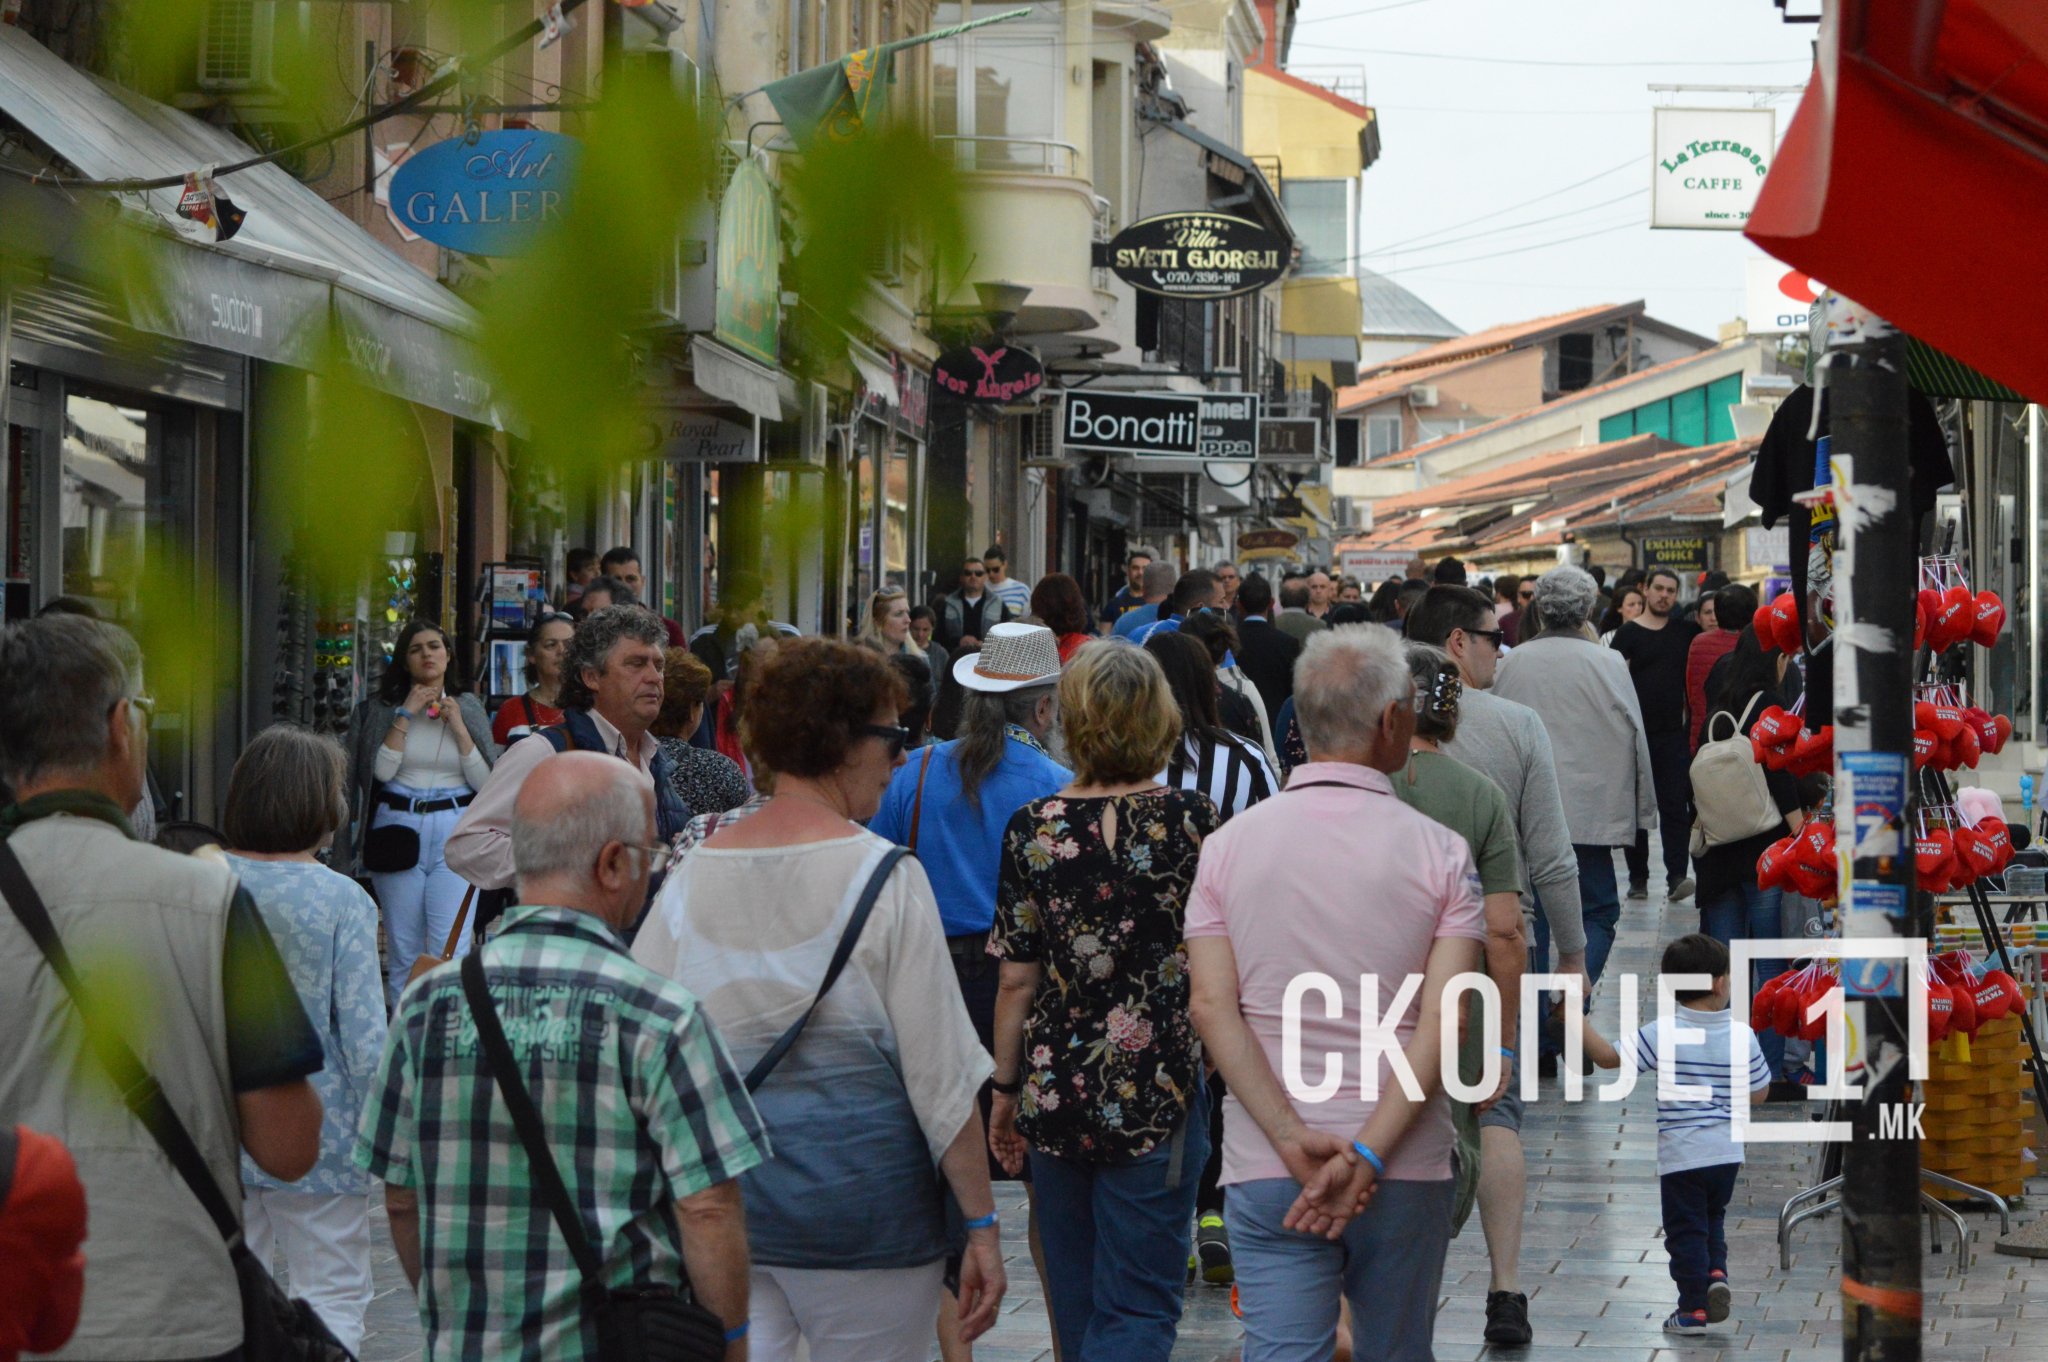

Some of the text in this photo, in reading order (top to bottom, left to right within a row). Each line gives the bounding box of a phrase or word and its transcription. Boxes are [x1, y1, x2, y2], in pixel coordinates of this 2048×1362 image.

[465, 137, 554, 180] Art
[1660, 139, 1767, 177] La Terrasse
[1683, 177, 1743, 191] CAFFE
[406, 190, 564, 224] GALER
[1704, 210, 1730, 219] since
[1738, 210, 1751, 220] 20
[1174, 228, 1218, 248] Villa
[1116, 247, 1279, 270] SVETI GJORGJI
[210, 291, 257, 337] swatch
[1777, 314, 1808, 327] OP
[936, 367, 1042, 400] For Angels
[669, 419, 720, 441] Royal
[1069, 399, 1195, 446] Bonatti
[697, 439, 746, 456] Pearl
[1200, 441, 1252, 456] ppa
[1645, 538, 1703, 550] EXCHANGE
[1656, 550, 1694, 561] OFFICE
[1976, 989, 2005, 1006] МАМА
